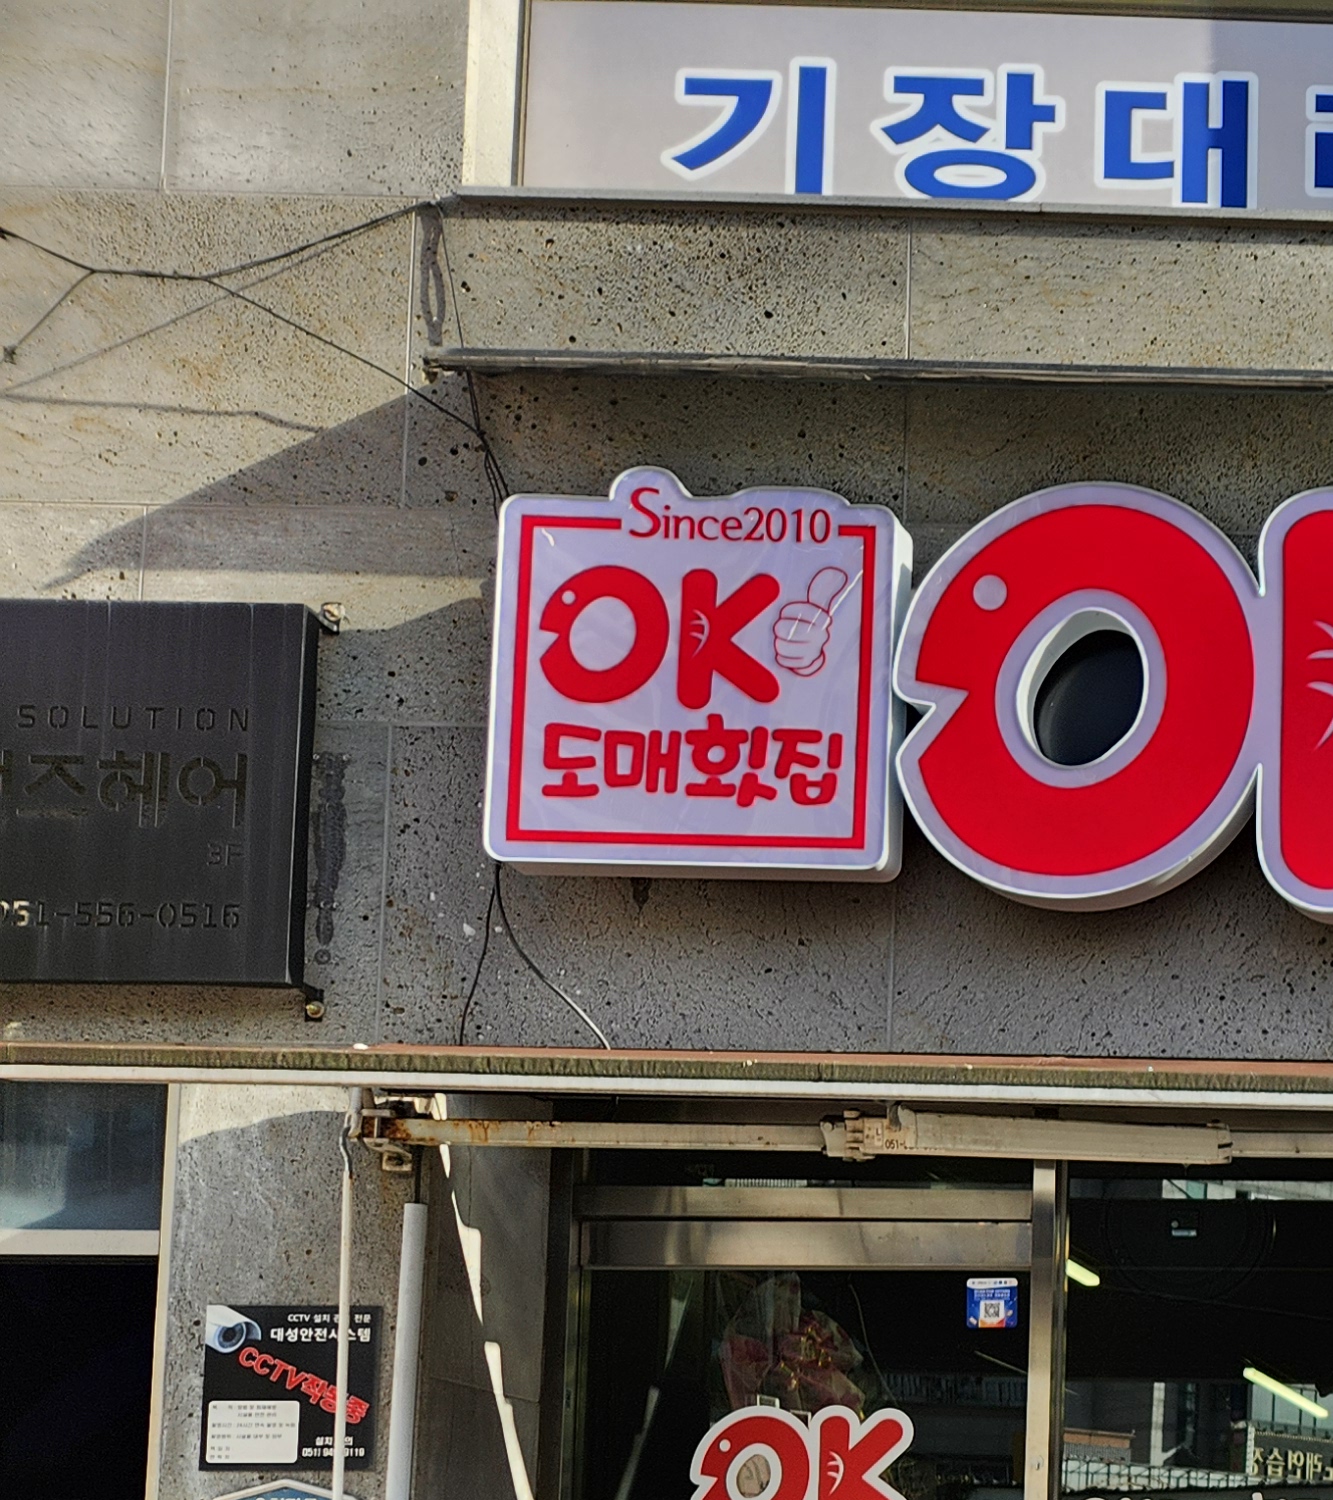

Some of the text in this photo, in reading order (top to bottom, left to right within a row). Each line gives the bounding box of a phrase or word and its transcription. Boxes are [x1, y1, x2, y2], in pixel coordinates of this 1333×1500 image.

[539, 564, 781, 710] OK
[17, 704, 249, 732] SOLUTION
[0, 750, 249, 829] 즈헤어
[540, 713, 844, 808] 도매횟집
[287, 1314, 311, 1323] CCTV
